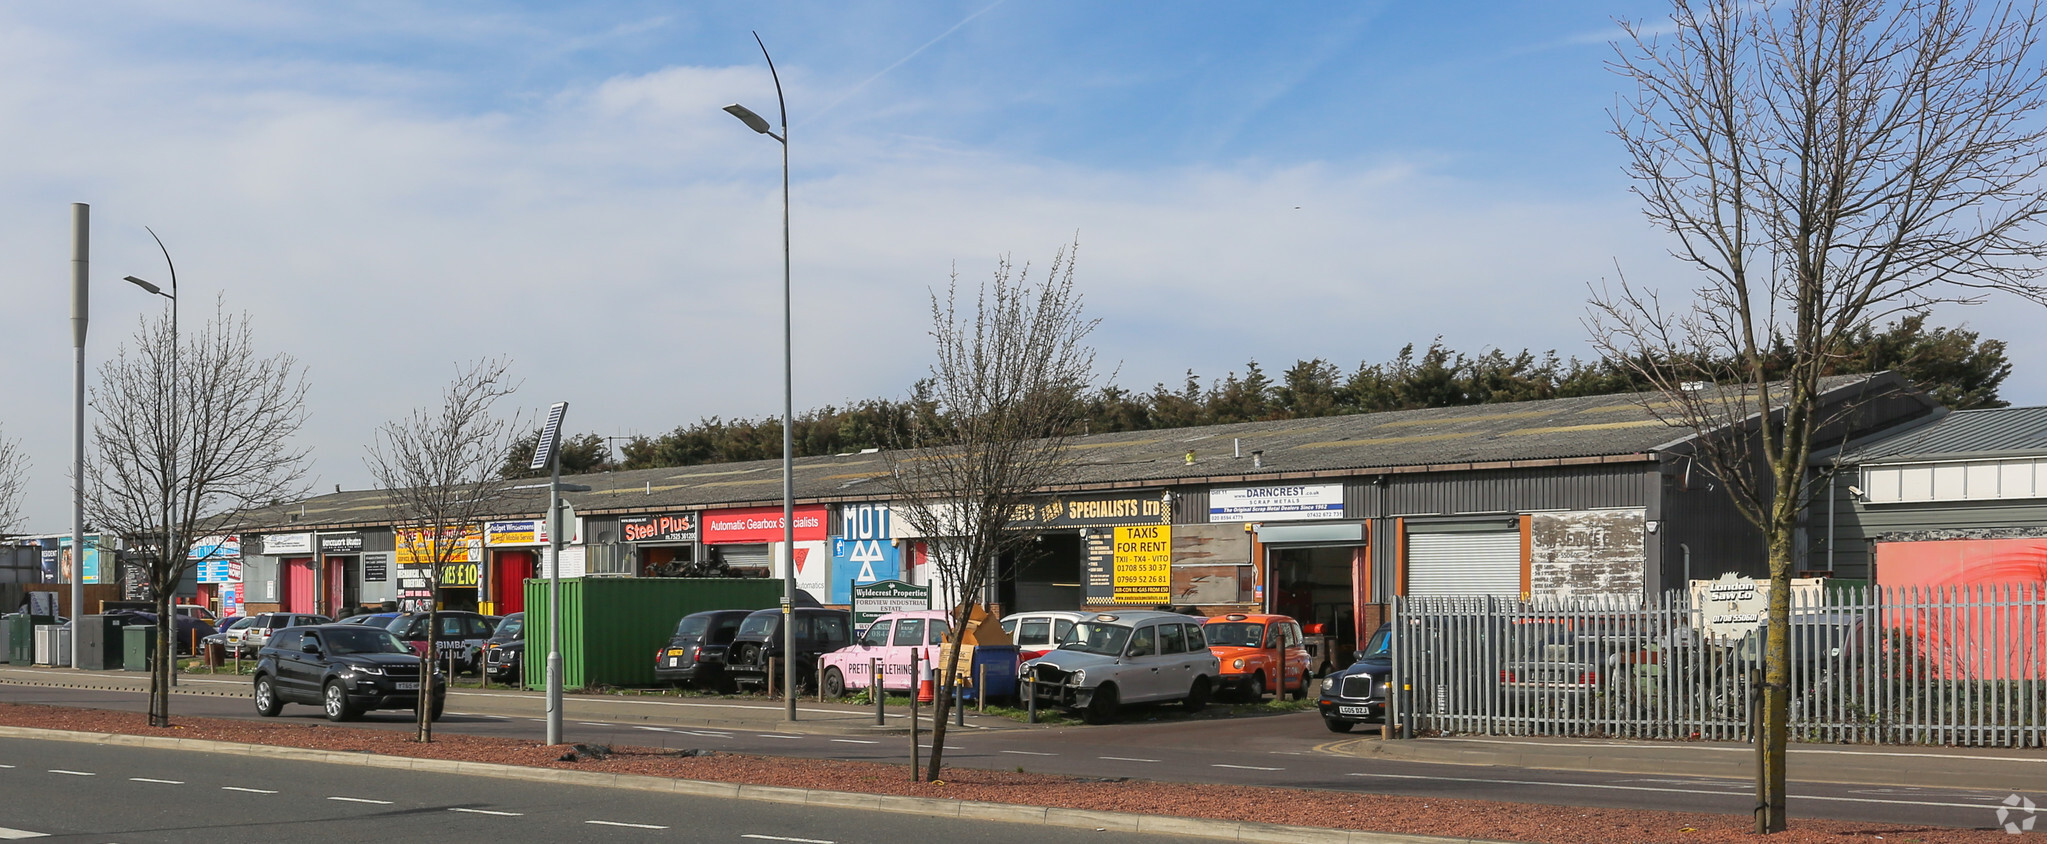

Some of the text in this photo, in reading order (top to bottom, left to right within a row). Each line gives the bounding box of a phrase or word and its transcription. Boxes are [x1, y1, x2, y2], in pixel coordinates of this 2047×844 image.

[1069, 499, 1138, 519] SPECIALISTS
[710, 519, 745, 531] Automatic
[746, 518, 777, 530] Gearbox
[779, 516, 819, 528] Scialists
[843, 503, 889, 540] MOT
[625, 519, 658, 541] Steel
[660, 515, 690, 535] Plus
[1127, 527, 1158, 539] TAXIS
[520, 533, 535, 541] Service
[1117, 541, 1167, 552] FOR RENT
[457, 564, 478, 585] £10
[1158, 575, 1166, 583] 81
[1710, 583, 1754, 592] London
[856, 589, 927, 598] Wyldecrest Properties
[1711, 591, 1753, 601] Saw Co
[1713, 615, 1732, 623] 01708
[436, 641, 466, 649] BIMBA
